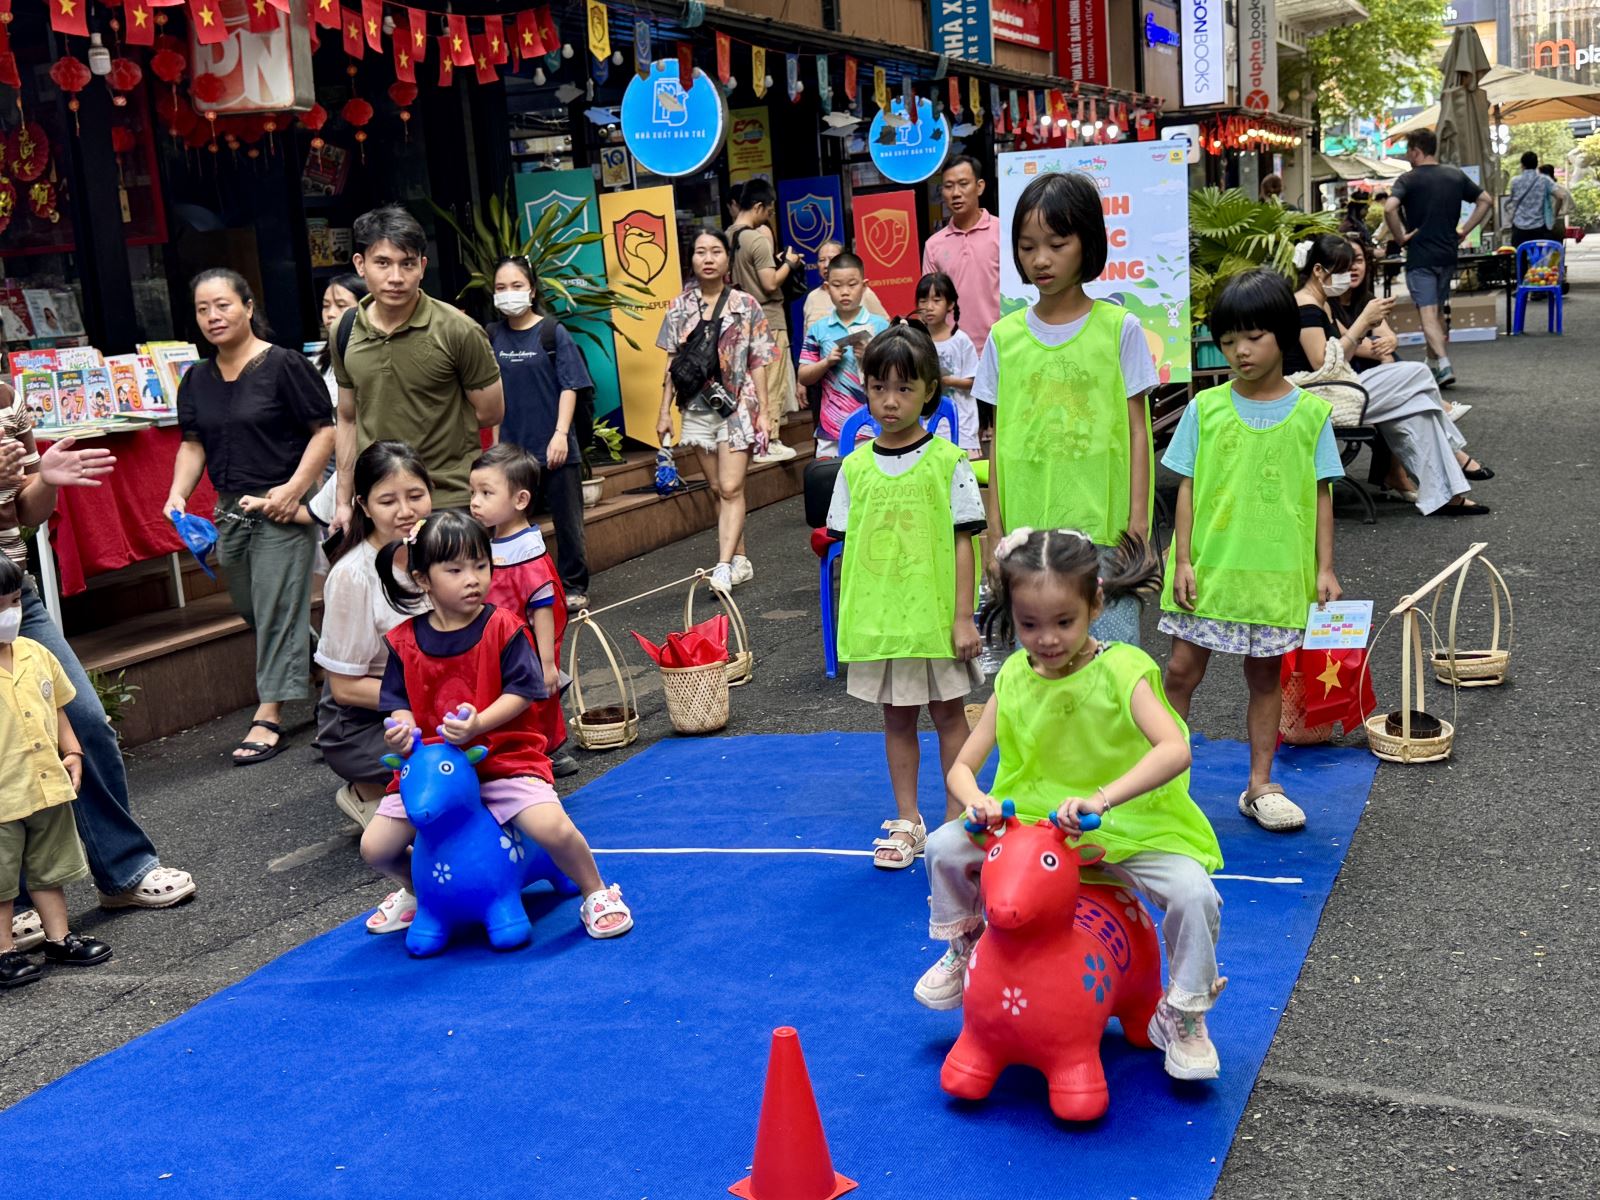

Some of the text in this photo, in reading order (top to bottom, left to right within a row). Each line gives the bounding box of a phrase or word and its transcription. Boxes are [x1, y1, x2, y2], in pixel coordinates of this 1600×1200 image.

[966, 0, 978, 25] PU
[938, 18, 964, 61] NHÀ
[1248, 0, 1264, 88] alphabook
[1086, 38, 1096, 79] NATIONAL
[603, 149, 624, 168] 10
[42, 394, 53, 412] 6
[74, 396, 84, 414] 7
[132, 391, 142, 408] 9
